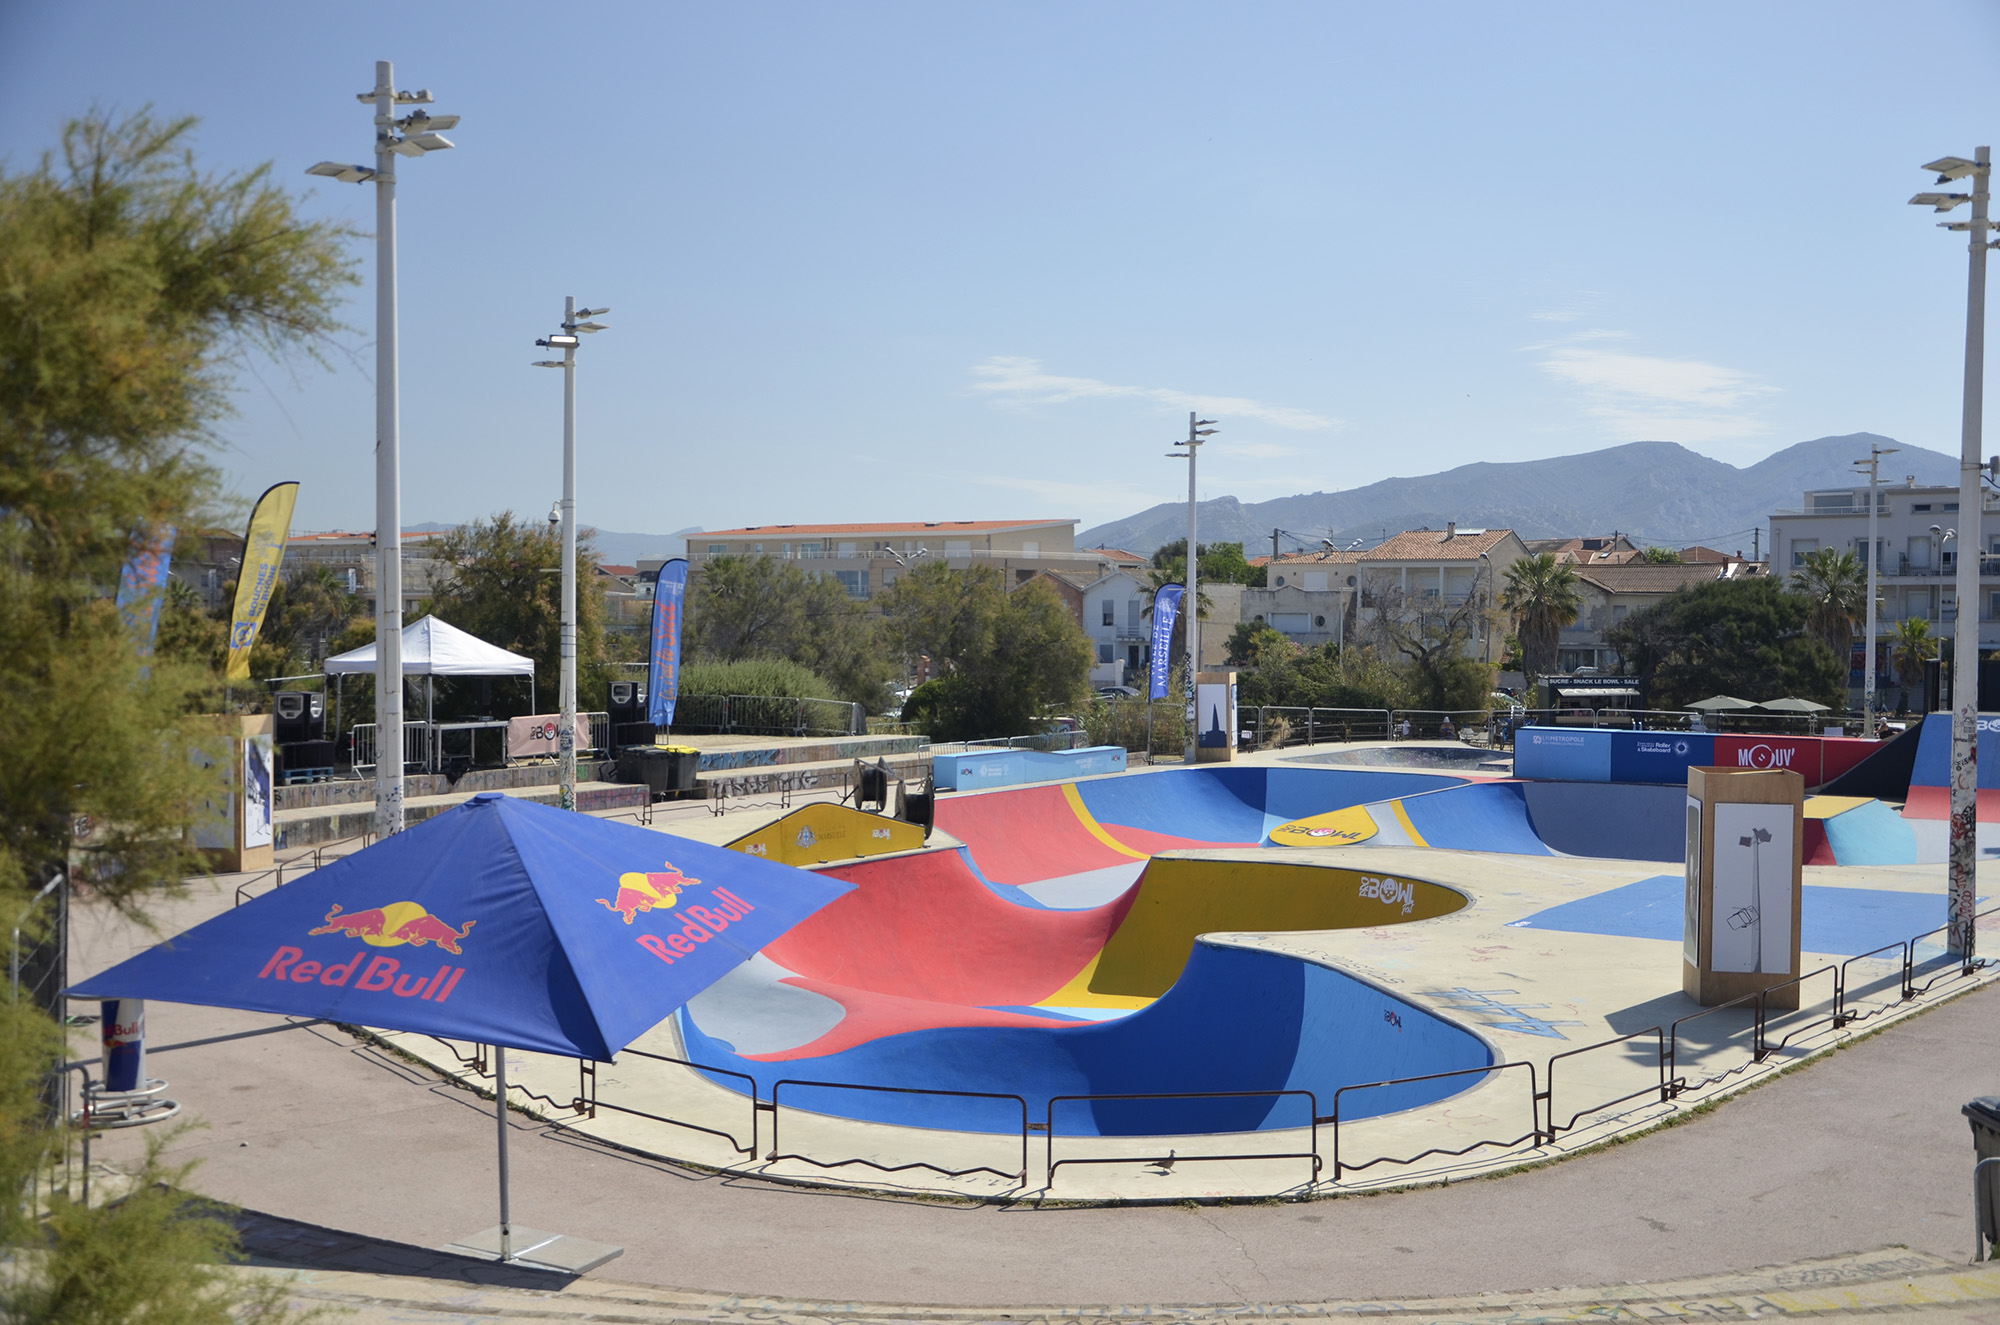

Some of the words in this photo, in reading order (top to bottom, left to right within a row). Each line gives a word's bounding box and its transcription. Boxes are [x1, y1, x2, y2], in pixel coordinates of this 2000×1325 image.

[248, 563, 268, 617] BOUCHES
[653, 599, 676, 648] Sud
[656, 647, 675, 661] le
[1157, 616, 1173, 687] MARSEILLE
[1738, 744, 1795, 768] MOUV'
[1289, 826, 1362, 839] BOWL
[1367, 878, 1415, 904] BOWL
[635, 912, 715, 965] Red
[685, 886, 756, 933] Bull
[257, 945, 367, 987] Red
[354, 955, 466, 1003] Bull
[113, 1022, 139, 1036] Bull
